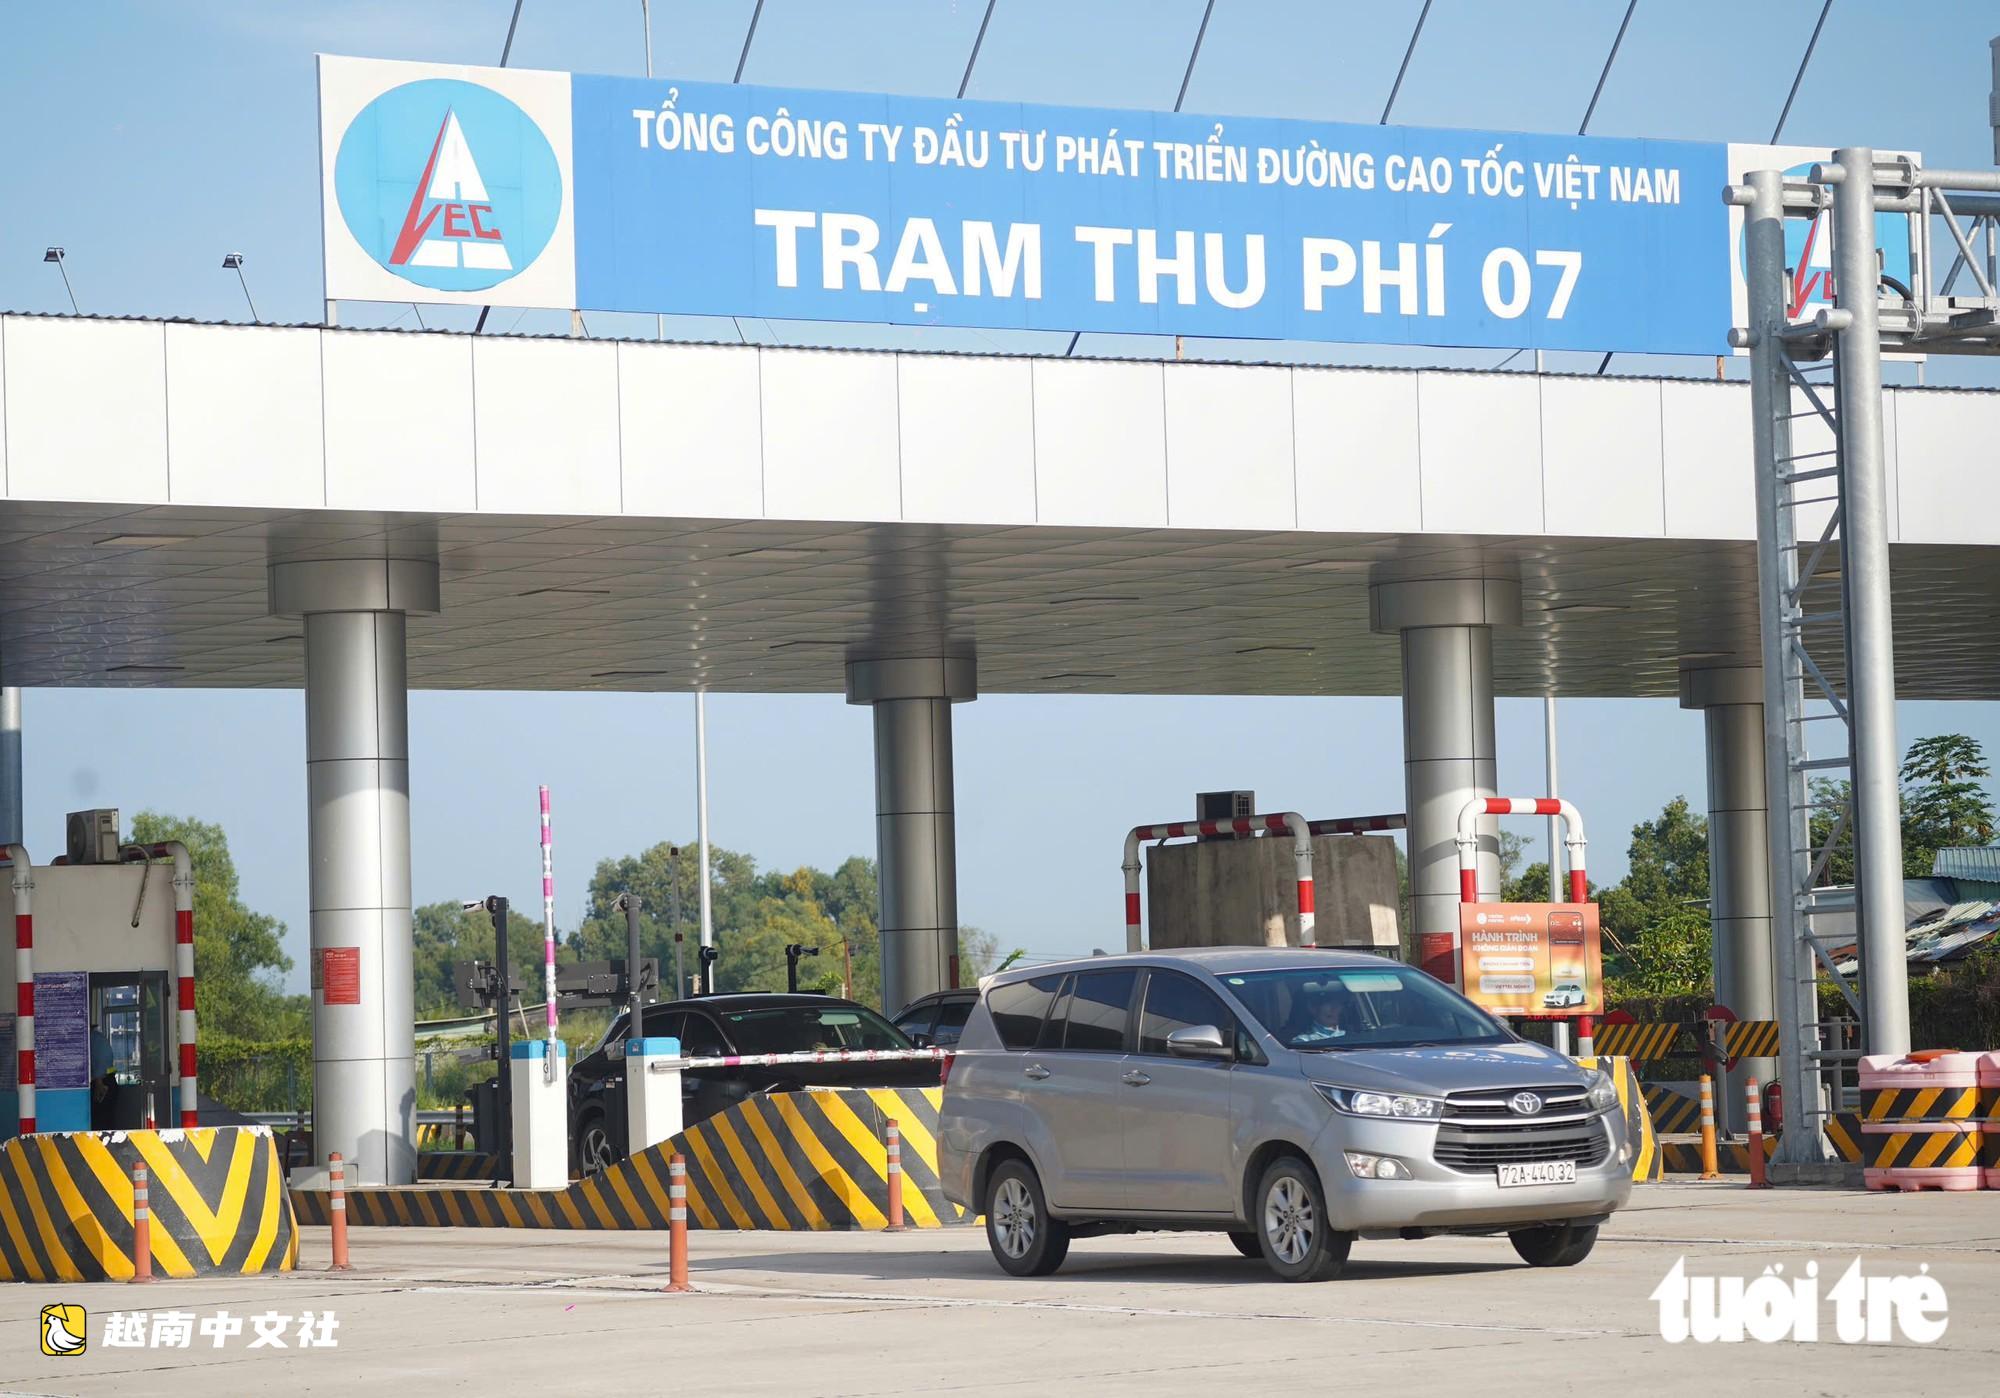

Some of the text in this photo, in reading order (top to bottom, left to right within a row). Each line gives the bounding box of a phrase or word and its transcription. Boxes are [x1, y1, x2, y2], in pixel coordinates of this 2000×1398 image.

[633, 88, 1680, 210] TỔNG CÔNG TY ĐẦU TƯ PHÁT TRIỂN ĐƯỜNG CAO TỐC VIỆT NAM
[754, 208, 1582, 320] TRẠM THU PHÍ 07
